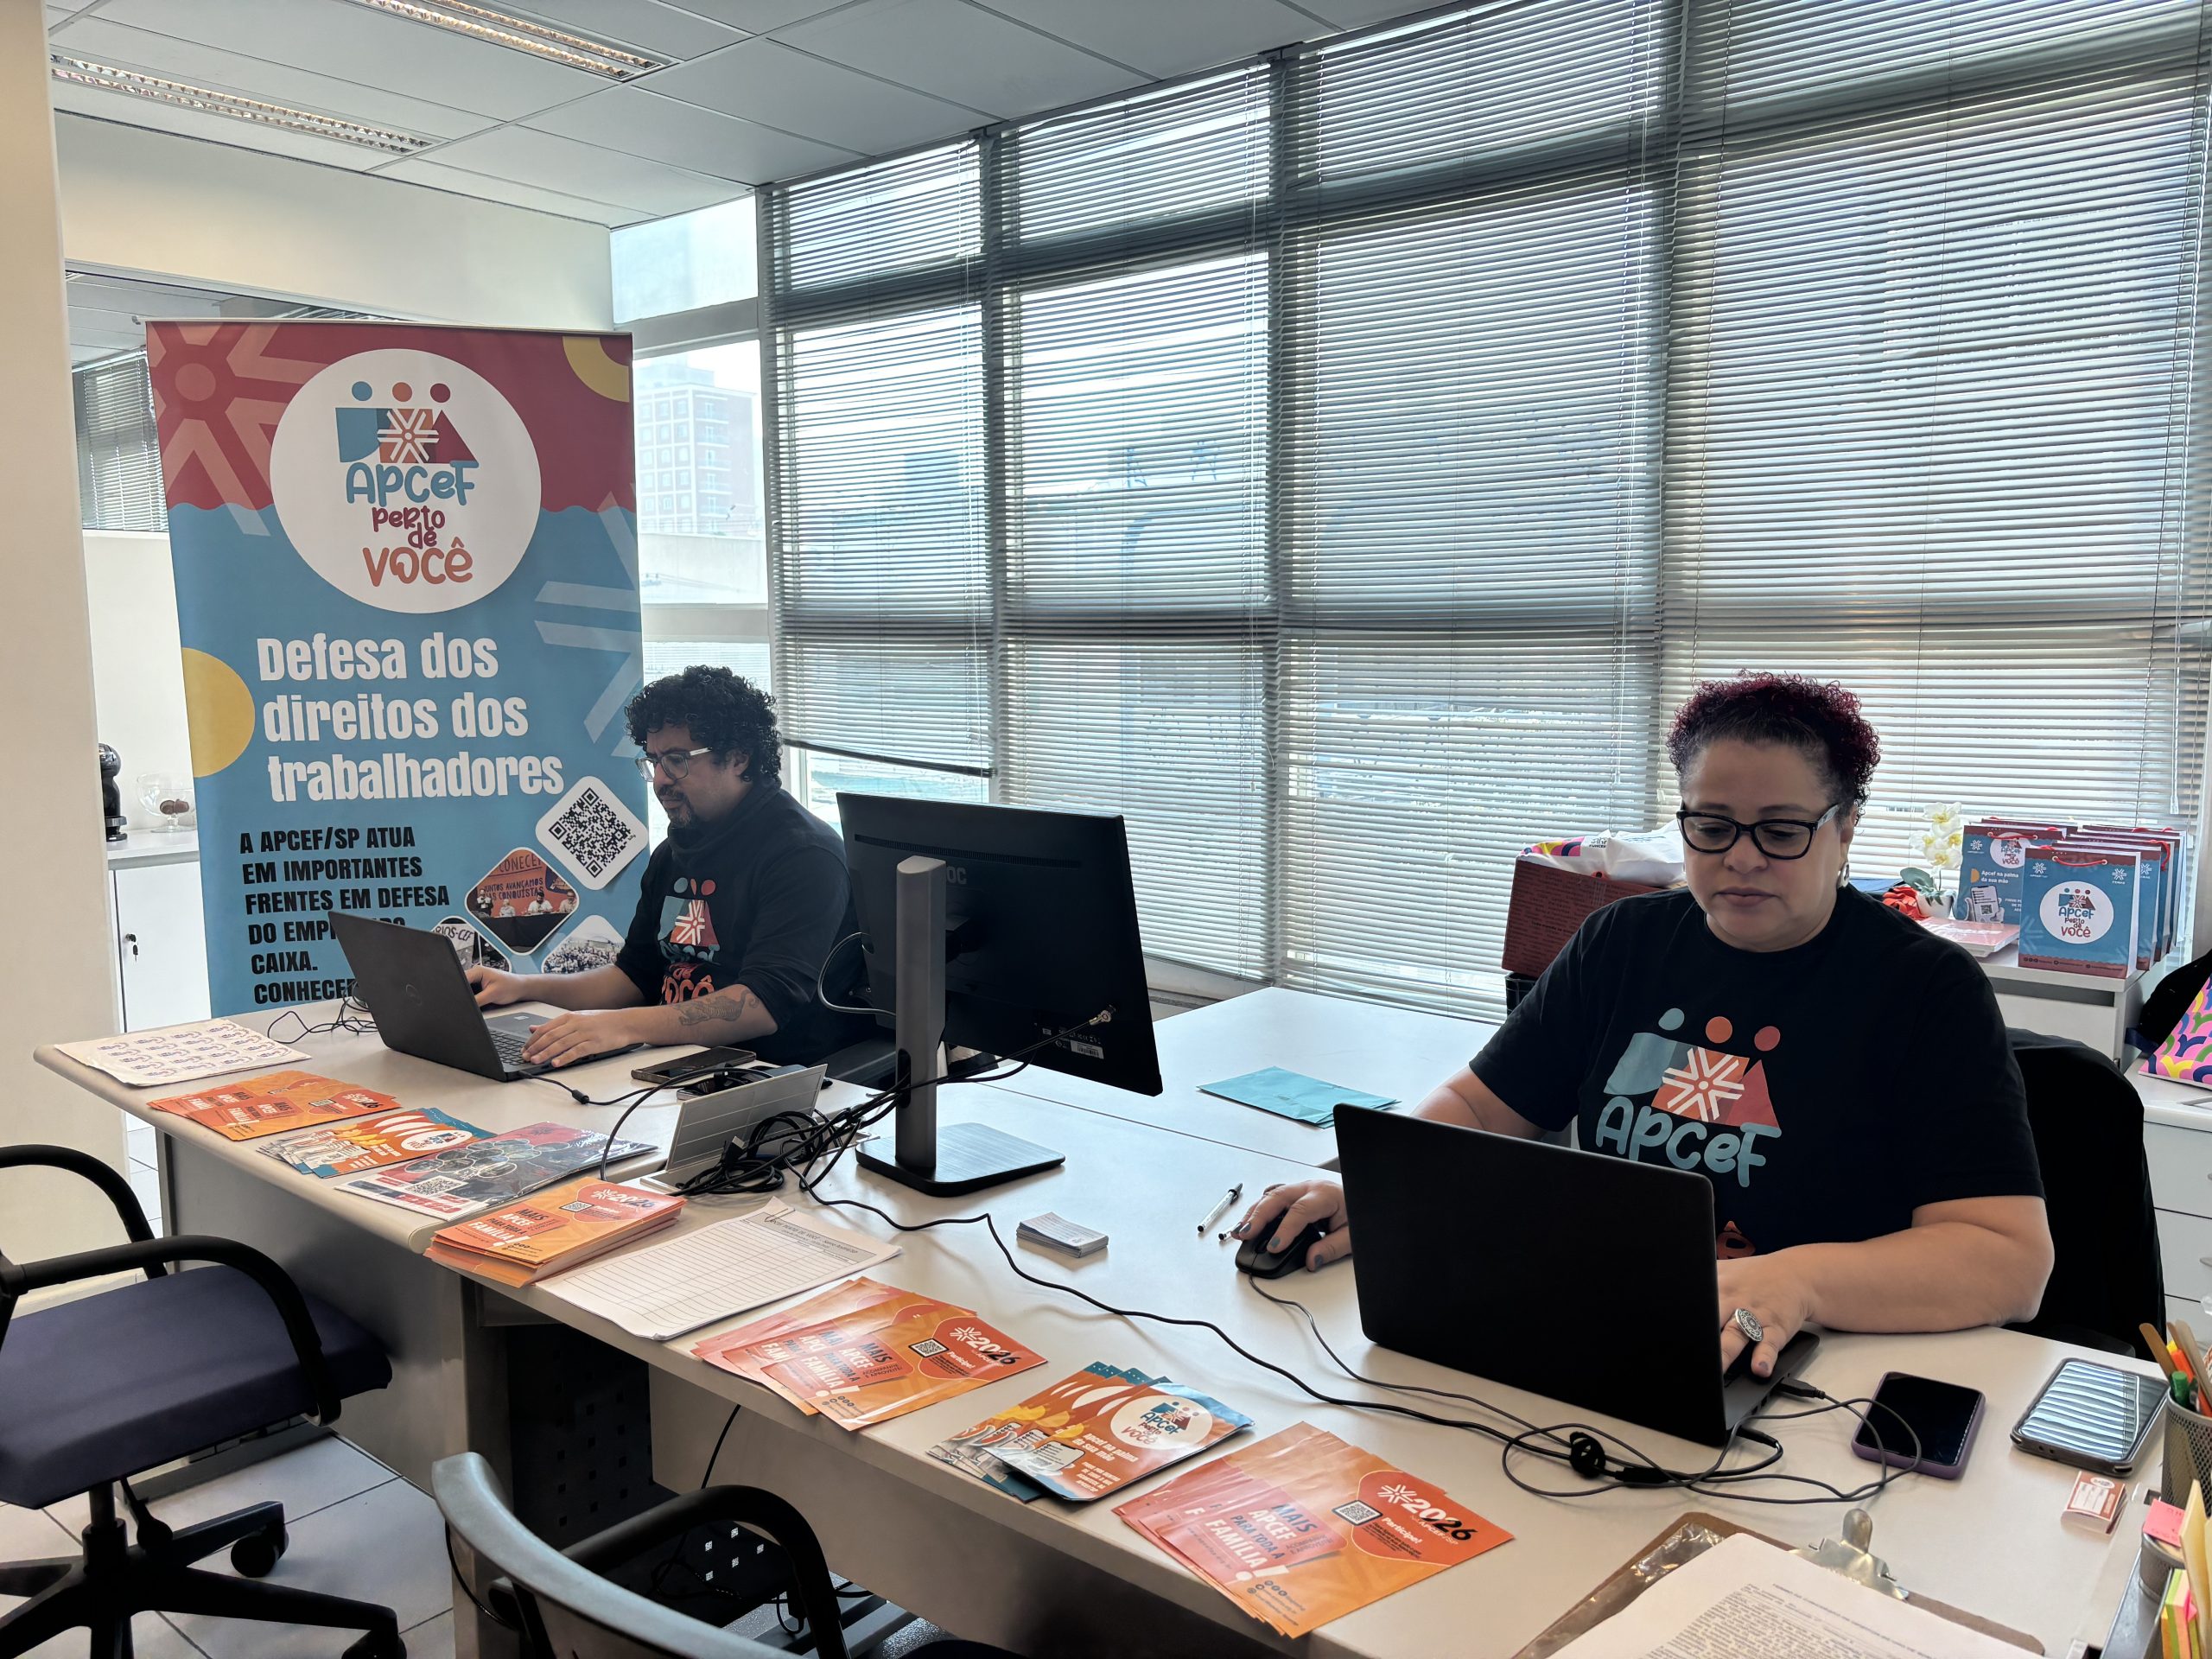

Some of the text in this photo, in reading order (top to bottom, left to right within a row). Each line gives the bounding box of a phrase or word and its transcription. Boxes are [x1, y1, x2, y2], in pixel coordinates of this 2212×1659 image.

[408, 522, 437, 550] de
[257, 632, 499, 681] Defesa dos
[263, 692, 528, 741] direitos dos
[268, 753, 564, 802] trabalhadores
[240, 826, 415, 854] A APCEF/SP ATUA
[243, 856, 423, 884] EM IMPORTANTES
[946, 866, 968, 885] OC
[245, 885, 450, 915] FRENTES EM DEFESA
[248, 921, 276, 944] DO
[251, 951, 318, 975] CAIXA.
[499, 1213, 535, 1226] APCEF
[515, 1209, 549, 1221] MAIS
[819, 1332, 843, 1345] MAI
[966, 1337, 1020, 1364] 2026
[838, 1347, 874, 1369] APCEF
[860, 1343, 893, 1363] MAIS
[838, 1363, 856, 1377] TODA
[1248, 1510, 1297, 1541] APCEF
[1271, 1503, 1318, 1533] MAIS
[1381, 1517, 1423, 1544] Participe!
[1401, 1498, 1478, 1541] 2026
[1230, 1515, 1257, 1534] PARA
[1251, 1533, 1278, 1553] TODA
